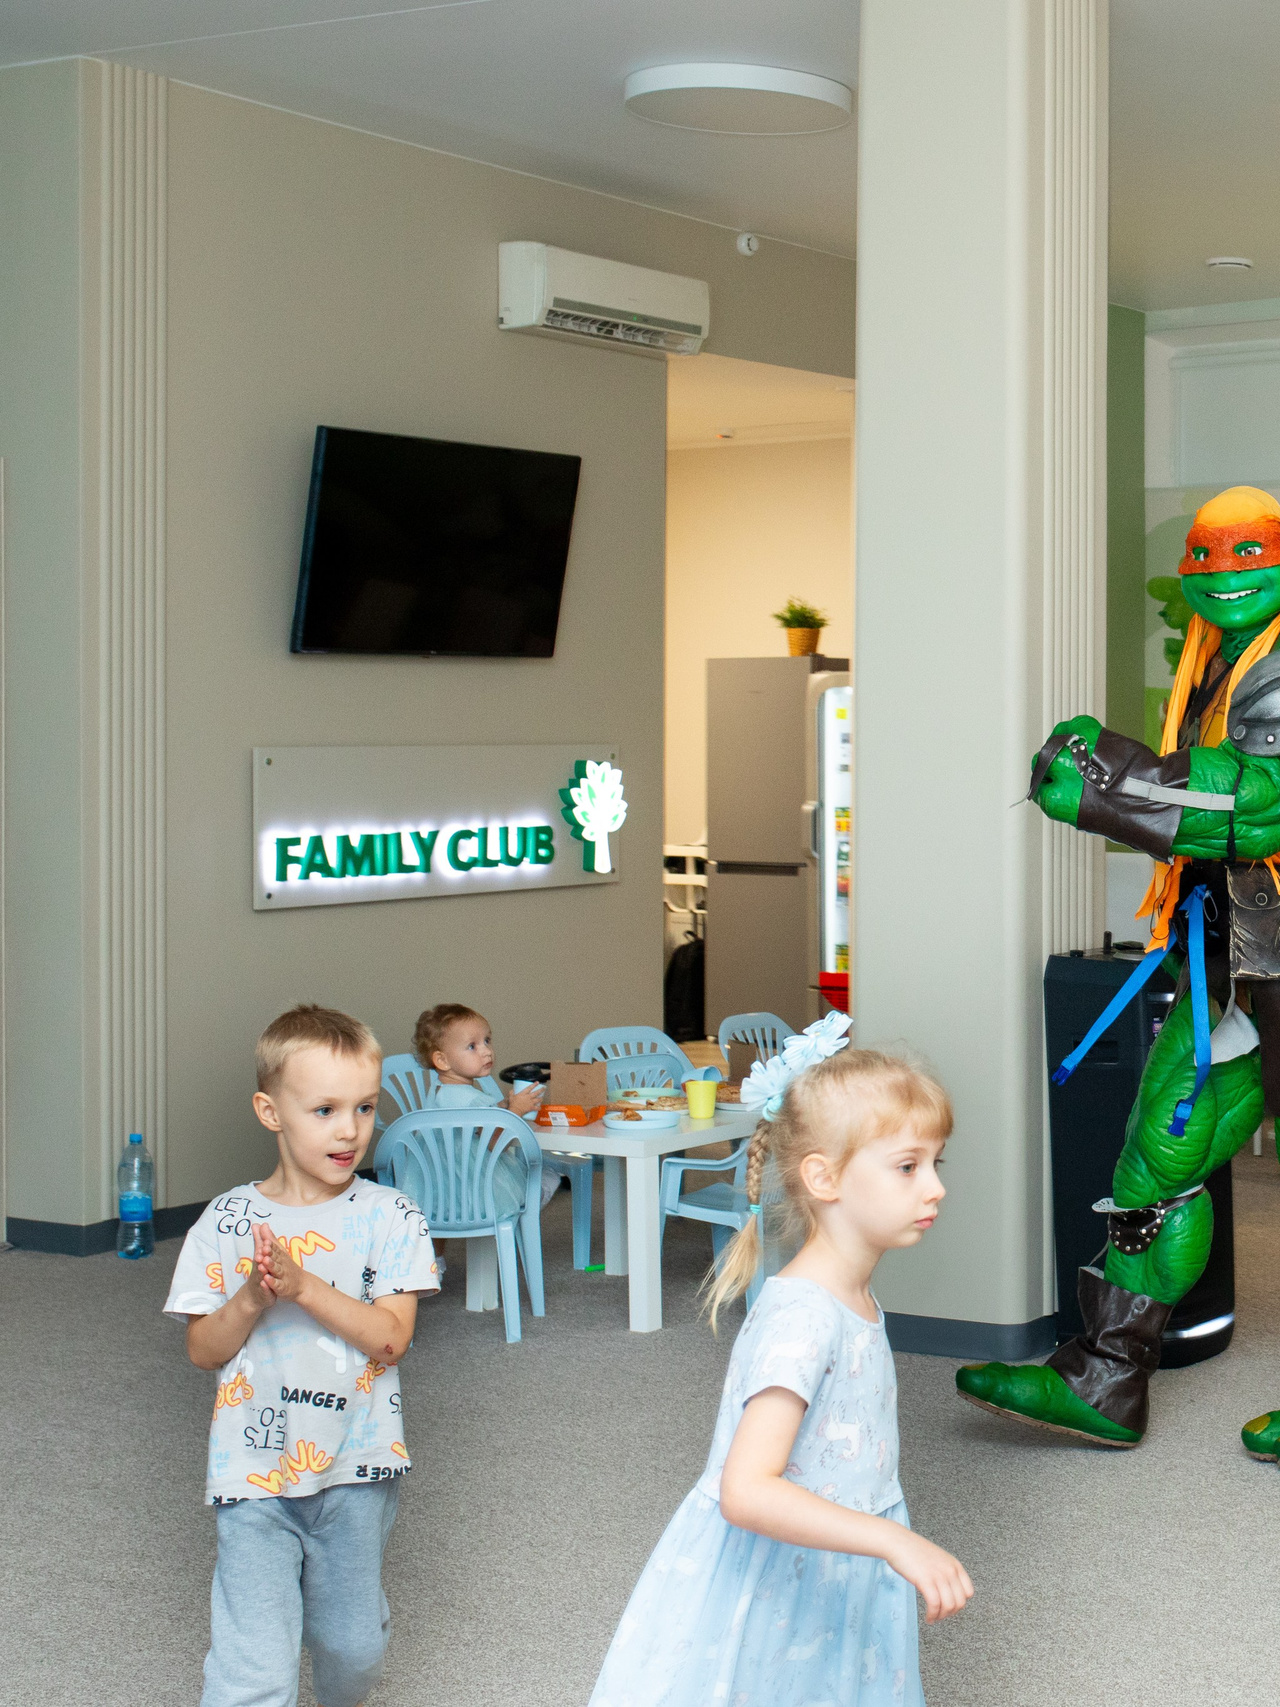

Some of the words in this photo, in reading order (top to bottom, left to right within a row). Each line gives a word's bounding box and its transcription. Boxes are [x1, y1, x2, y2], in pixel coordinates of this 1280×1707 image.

[276, 830, 439, 882] FAMILY
[447, 825, 555, 872] CLUB
[281, 1386, 348, 1412] DANGER
[243, 1426, 287, 1451] ET'S
[246, 1439, 334, 1495] WAVE
[355, 1464, 413, 1481] ANGER
